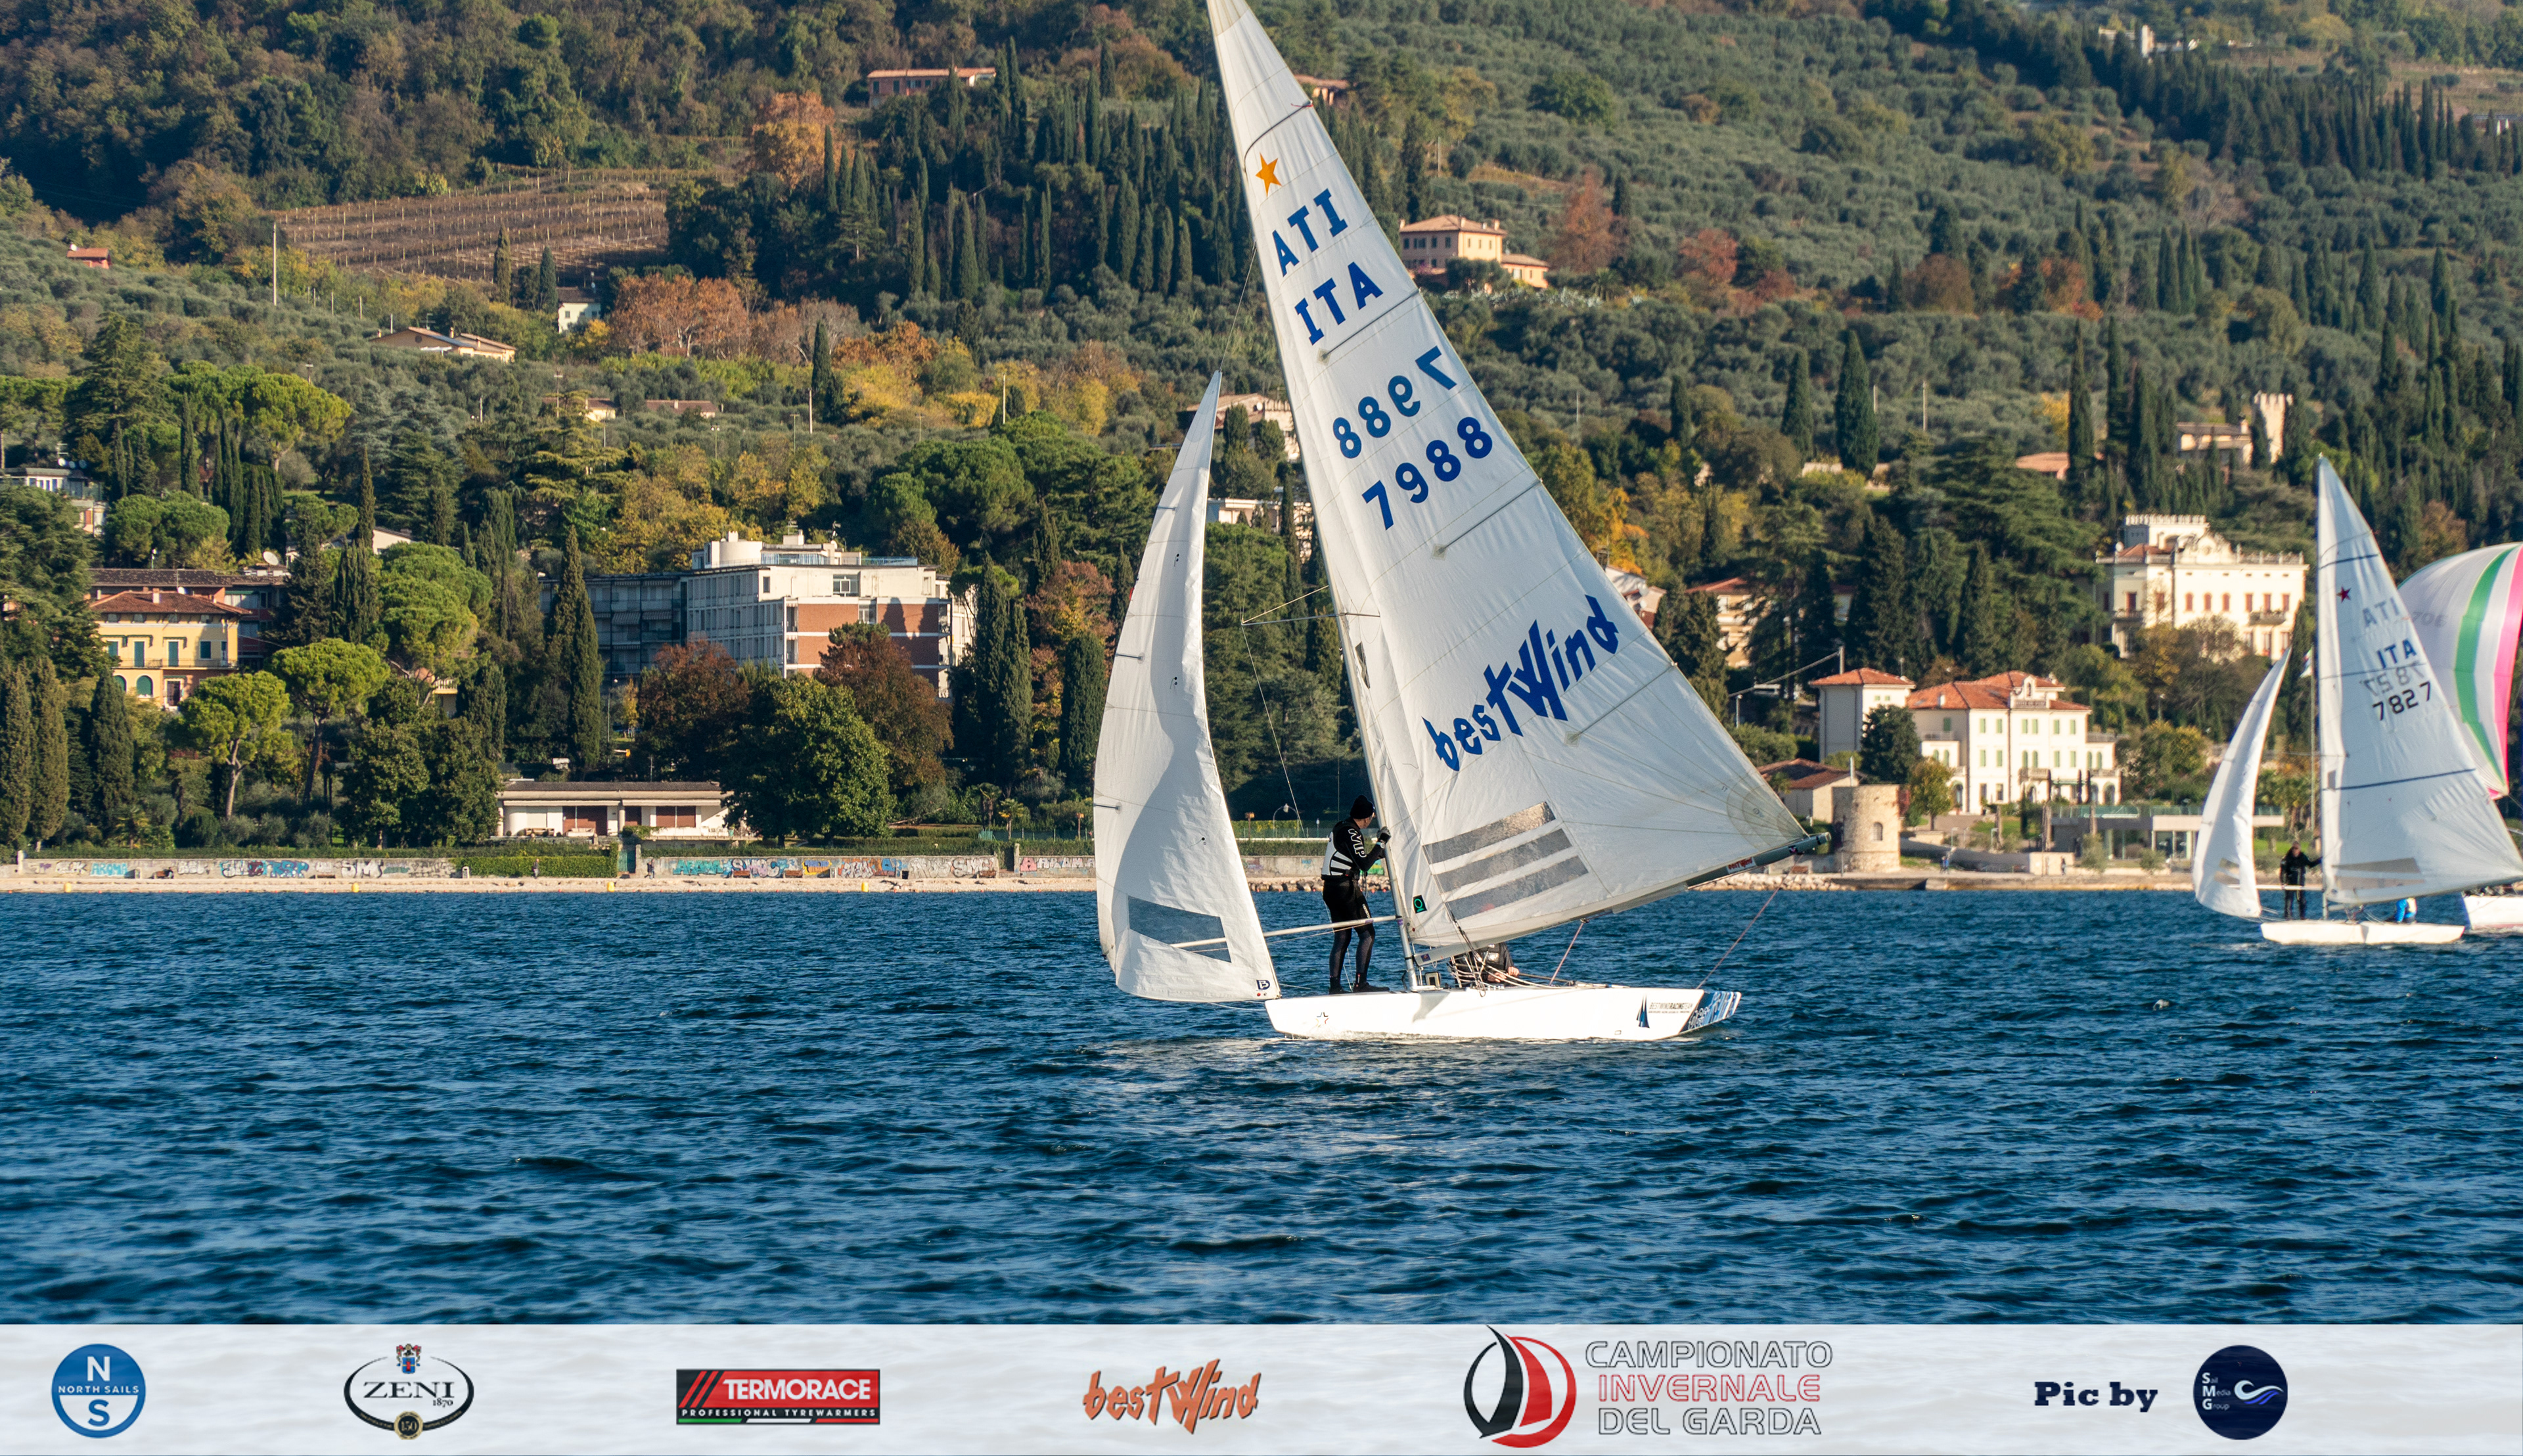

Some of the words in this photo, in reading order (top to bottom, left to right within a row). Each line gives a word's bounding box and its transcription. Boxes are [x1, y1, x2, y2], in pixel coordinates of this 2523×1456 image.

[1294, 262, 1384, 346] ITA
[1361, 417, 1493, 531] 7988
[2376, 637, 2417, 670] ITA
[2372, 681, 2431, 721] 7827
